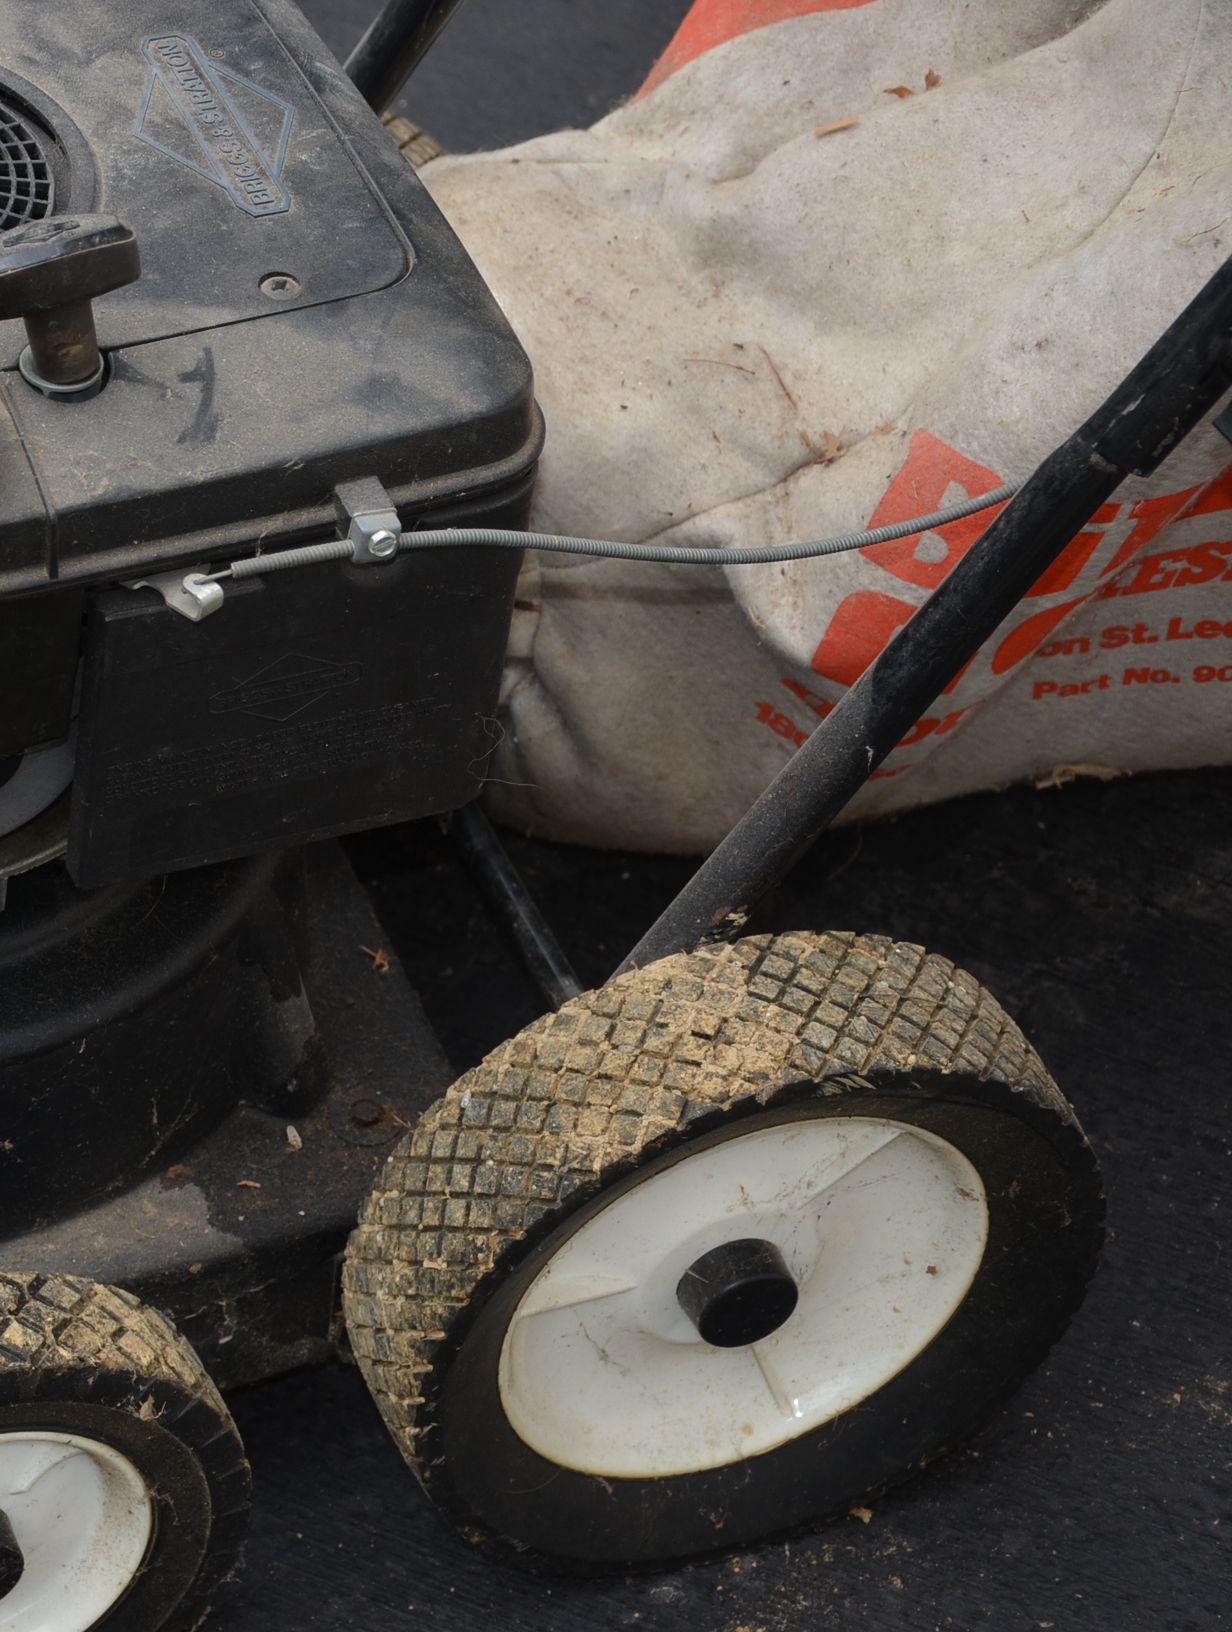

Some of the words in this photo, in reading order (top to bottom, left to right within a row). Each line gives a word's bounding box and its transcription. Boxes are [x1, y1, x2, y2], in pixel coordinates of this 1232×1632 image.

[158, 41, 224, 124] STRATTON
[211, 126, 233, 139] &
[219, 140, 274, 206] BRIGGS
[1098, 623, 1159, 649] St.
[1032, 673, 1112, 700] Part
[1122, 665, 1182, 686] No.
